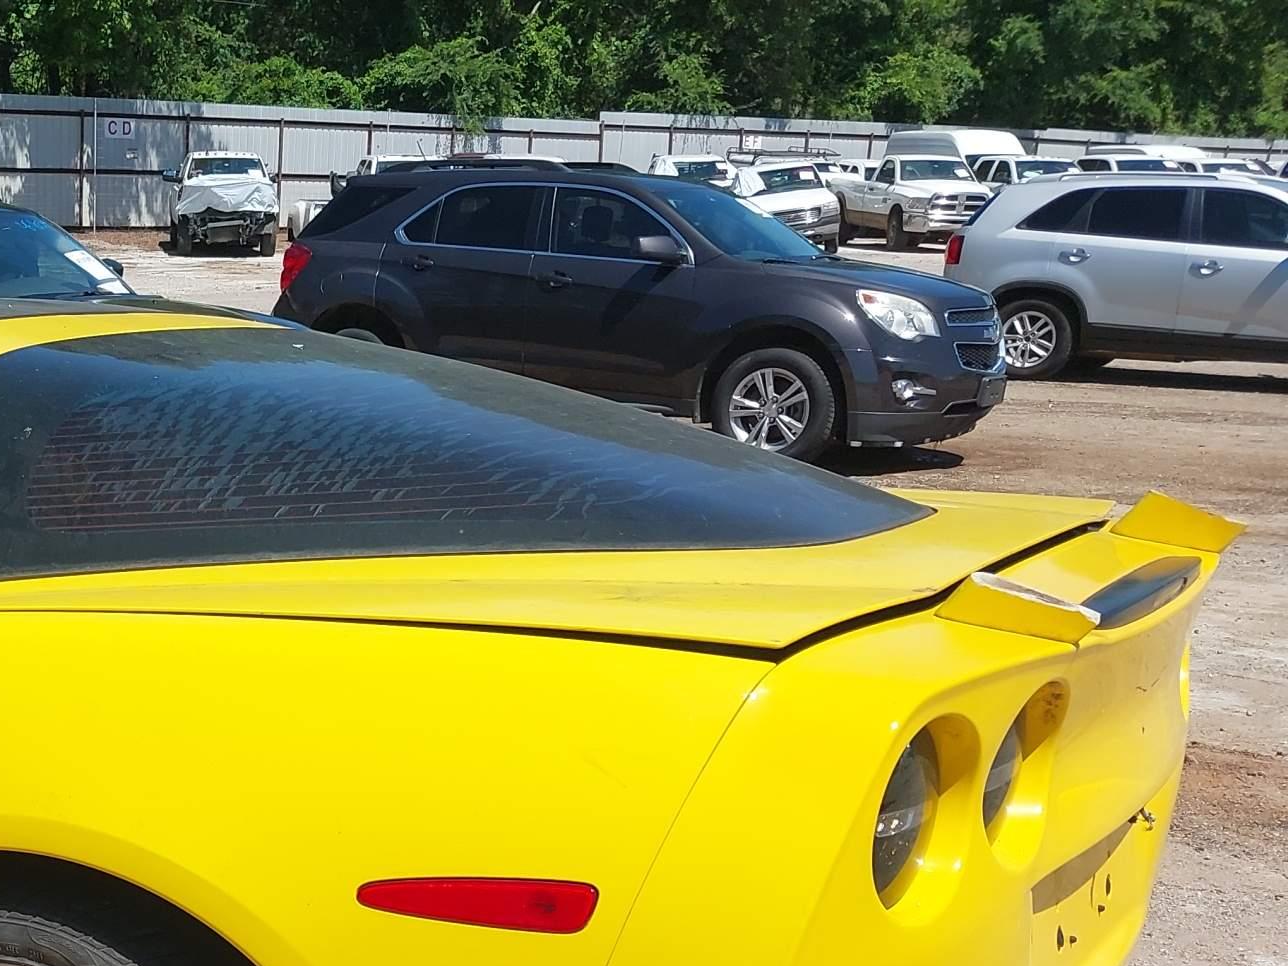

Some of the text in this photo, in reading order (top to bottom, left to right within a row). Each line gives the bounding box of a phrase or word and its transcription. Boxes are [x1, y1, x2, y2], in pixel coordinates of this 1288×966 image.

[108, 120, 132, 135] C D
[744, 135, 759, 147] E F
